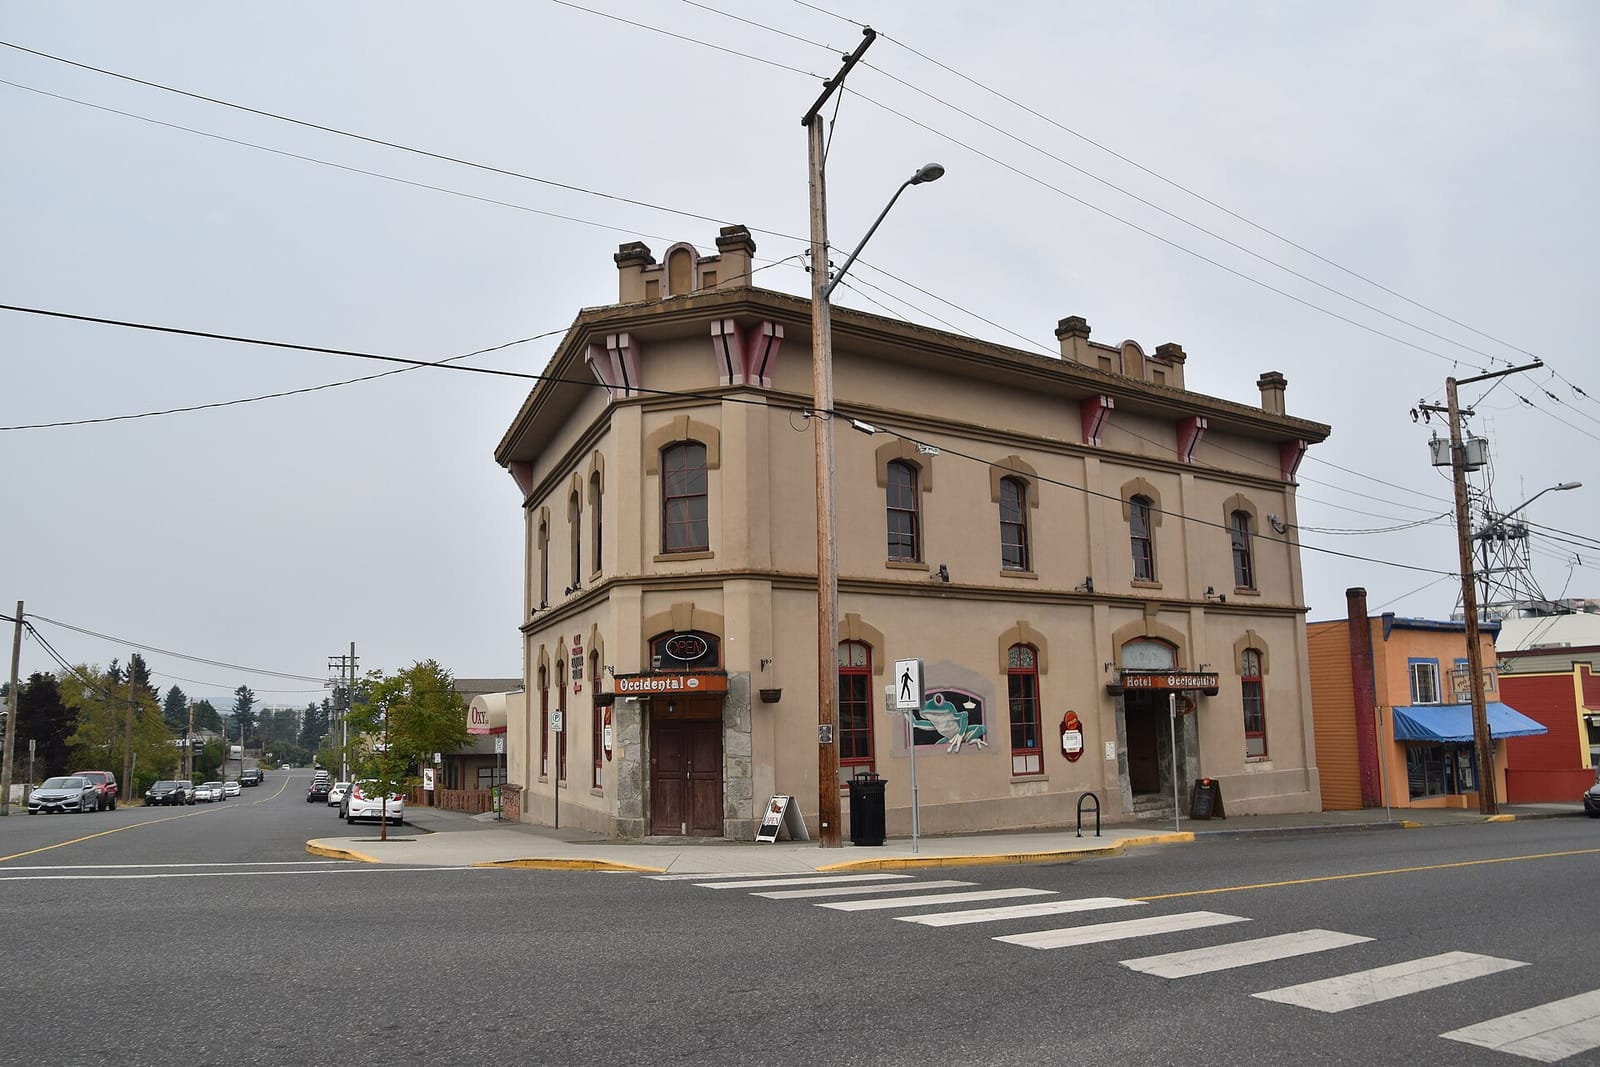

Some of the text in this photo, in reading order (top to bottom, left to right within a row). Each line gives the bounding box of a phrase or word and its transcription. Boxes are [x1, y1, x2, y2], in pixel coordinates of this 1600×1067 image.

[669, 640, 704, 656] OPEN
[620, 676, 684, 692] Occidental
[1126, 676, 1152, 687] Hotel
[1167, 675, 1209, 688] Occidental
